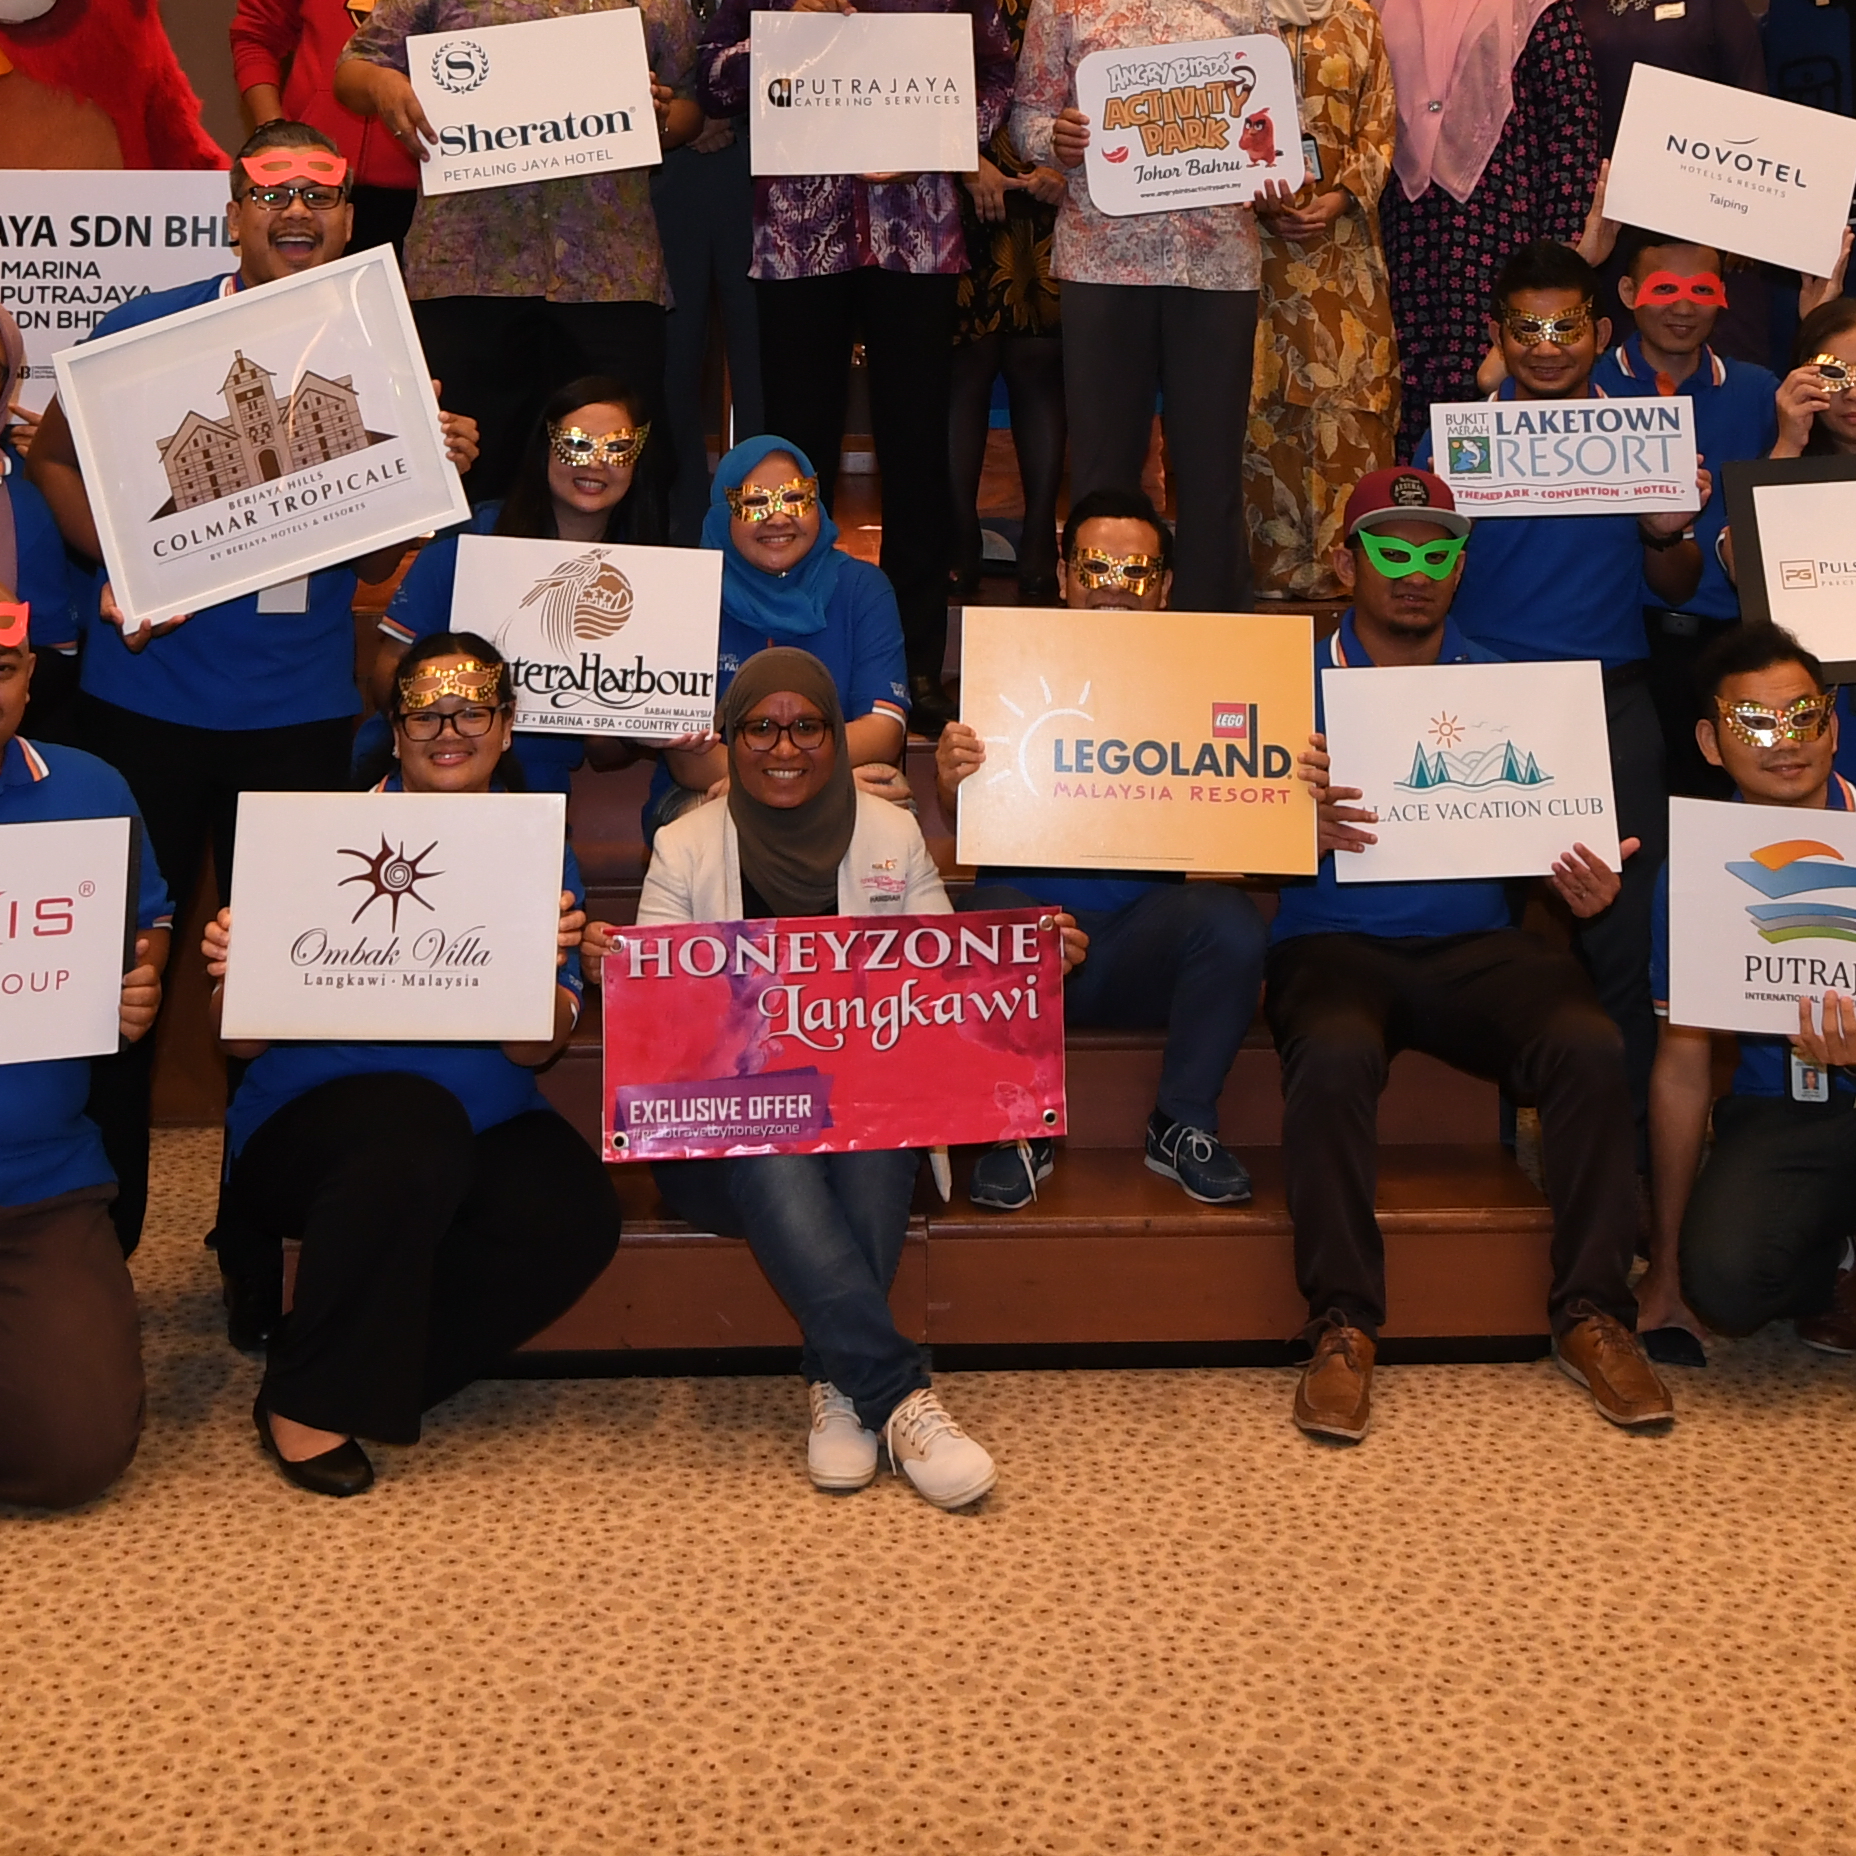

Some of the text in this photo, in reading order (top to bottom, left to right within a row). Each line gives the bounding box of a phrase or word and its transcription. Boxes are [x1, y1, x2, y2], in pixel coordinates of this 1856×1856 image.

[794, 77, 957, 95] PUTRAJAYA
[1106, 52, 1231, 93] ANGRY BIRDS
[794, 94, 962, 107] CATERING SERVICES
[1102, 78, 1253, 131] ACTIVITY
[437, 107, 634, 158] Sheraton
[1139, 117, 1231, 157] PARK
[443, 148, 615, 182] PETALING JAYA HOTEL
[1133, 157, 1243, 185] Johor Bahru
[1665, 134, 1808, 189] NOVOTEL
[1680, 163, 1788, 199] HOTELS & RESORTS
[1708, 192, 1750, 215] Taiping
[69, 214, 152, 249] SDN
[0, 260, 101, 280] MARINA
[1445, 411, 1489, 427] BUKIT
[1446, 425, 1490, 436] MERAH
[1494, 407, 1680, 436] LAKETOWN
[1496, 434, 1682, 478] RESORT
[228, 470, 325, 512] BERJAYA HILLS
[1540, 486, 1620, 499] CONVENTION
[1633, 484, 1678, 496] HOTELS
[152, 457, 409, 559] COLMAR TROPICALE
[210, 550, 223, 561] BY
[226, 535, 268, 557] BERJAYA
[270, 522, 310, 543] HOTELS
[323, 502, 366, 524] RESORTS
[539, 715, 583, 727] MARINA
[593, 717, 615, 729] SPA
[625, 719, 679, 731] COUNTRY
[644, 706, 672, 716] SABAH
[1215, 711, 1245, 729] LEGO
[1053, 709, 1292, 780] LEGOLAND
[1052, 781, 1292, 806] MALAYSIA RESORT
[1435, 796, 1604, 821] VACATION CLUB
[289, 924, 494, 969] Ombak Villa
[627, 921, 1042, 979] HONEYZONE
[303, 972, 480, 990] Langkawi Malaysia
[757, 974, 1041, 1051] Langkawi
[1744, 991, 1821, 1004] INTERNATIOAL
[629, 1093, 812, 1124] EXCLUSIVE OFFER
